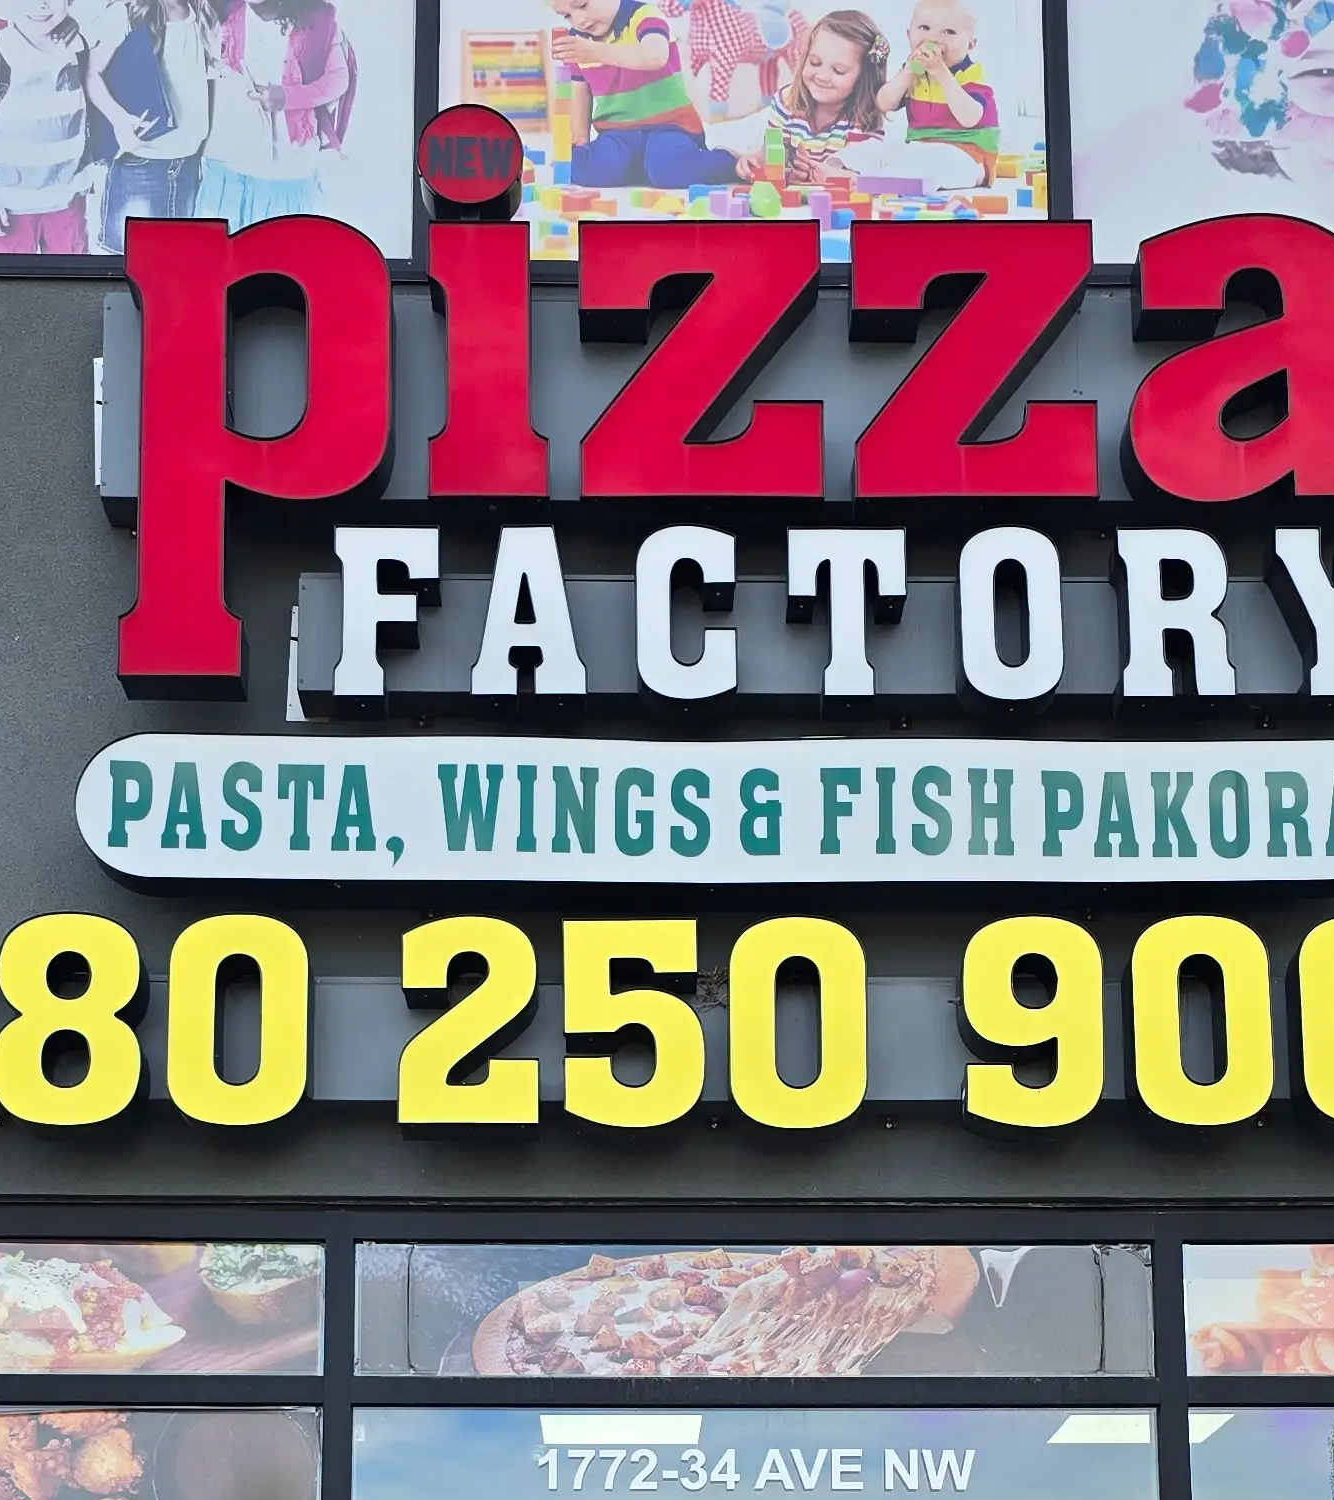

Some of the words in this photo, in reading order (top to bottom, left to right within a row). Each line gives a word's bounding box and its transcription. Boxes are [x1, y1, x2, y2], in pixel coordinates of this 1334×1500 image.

[428, 135, 515, 179] NEW
[108, 760, 405, 868] PASTA,
[438, 764, 710, 857] WINGS
[739, 767, 782, 856] &
[820, 765, 1015, 856] FISH
[399, 914, 868, 1127] 250
[537, 1448, 741, 1491] 1772-34
[754, 1448, 865, 1491] AVE
[882, 1448, 976, 1491] NW
